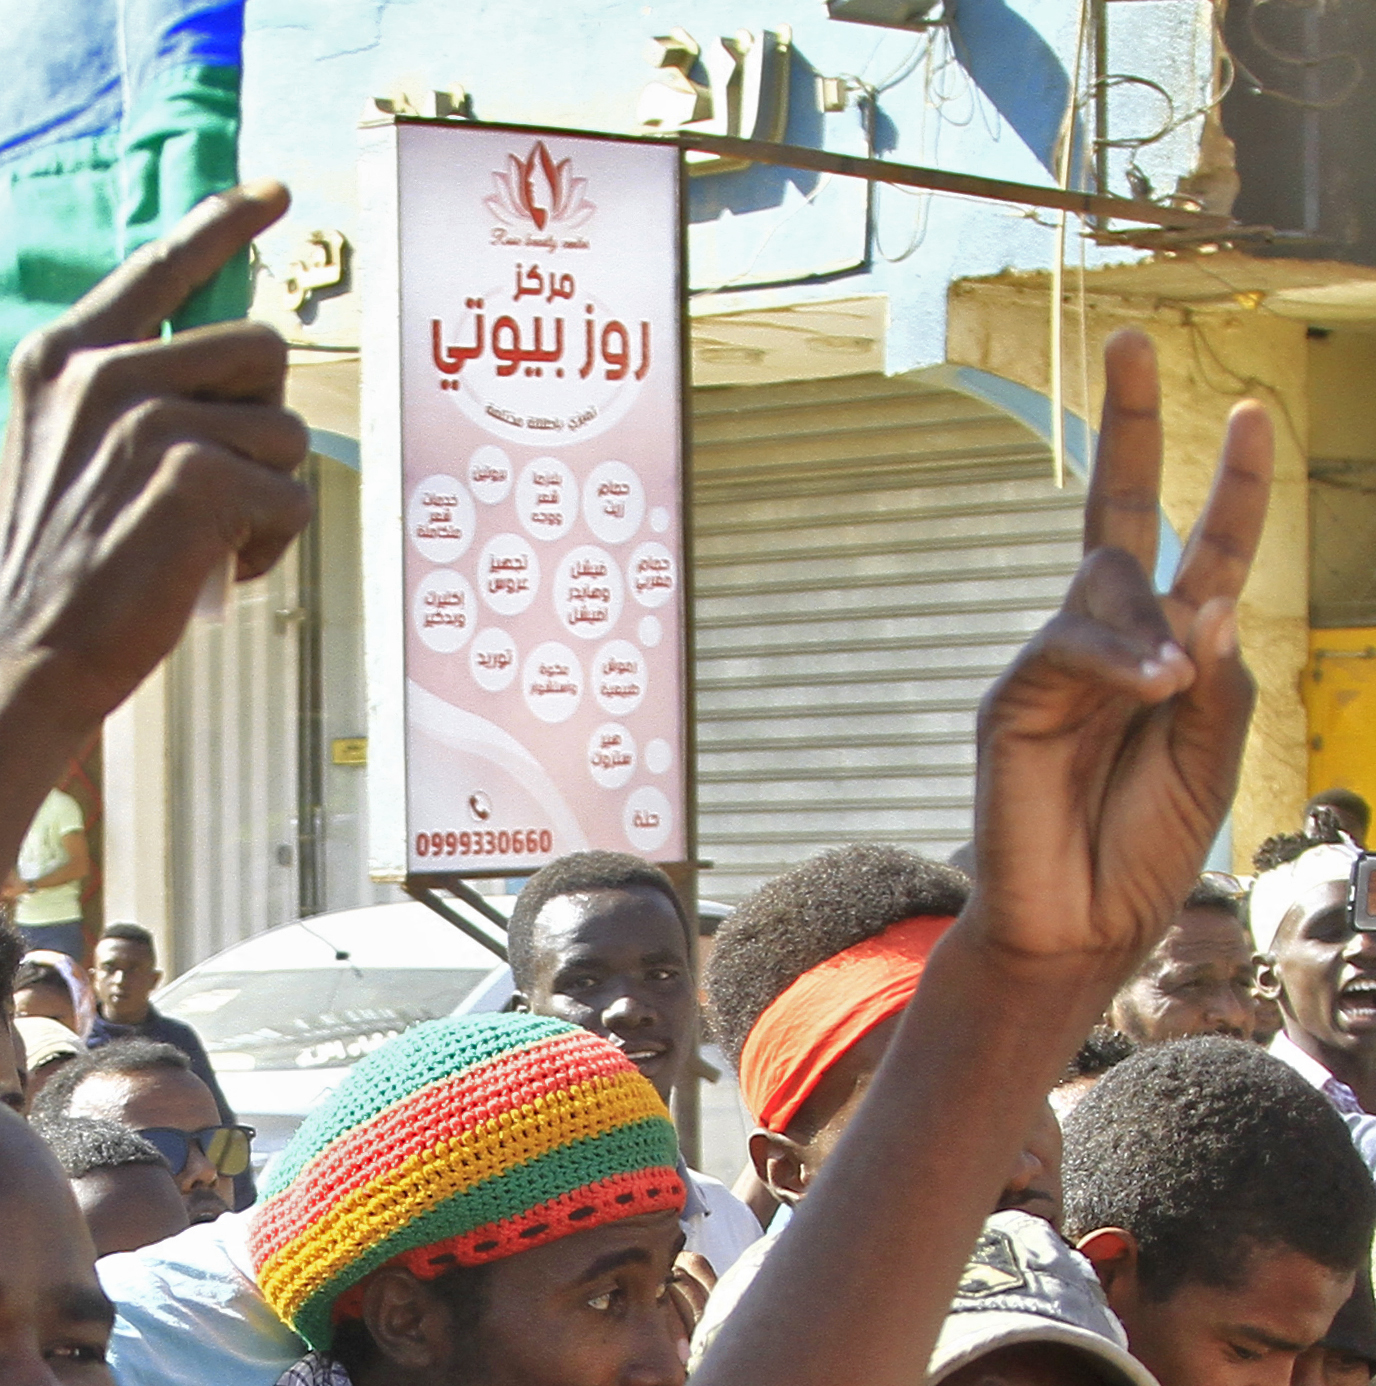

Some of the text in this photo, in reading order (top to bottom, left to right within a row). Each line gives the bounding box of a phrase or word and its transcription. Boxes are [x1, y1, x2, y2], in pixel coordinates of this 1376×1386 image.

[513, 262, 575, 302] مركز
[431, 297, 651, 391] روز بيوتي
[415, 829, 554, 857] 0999330660
